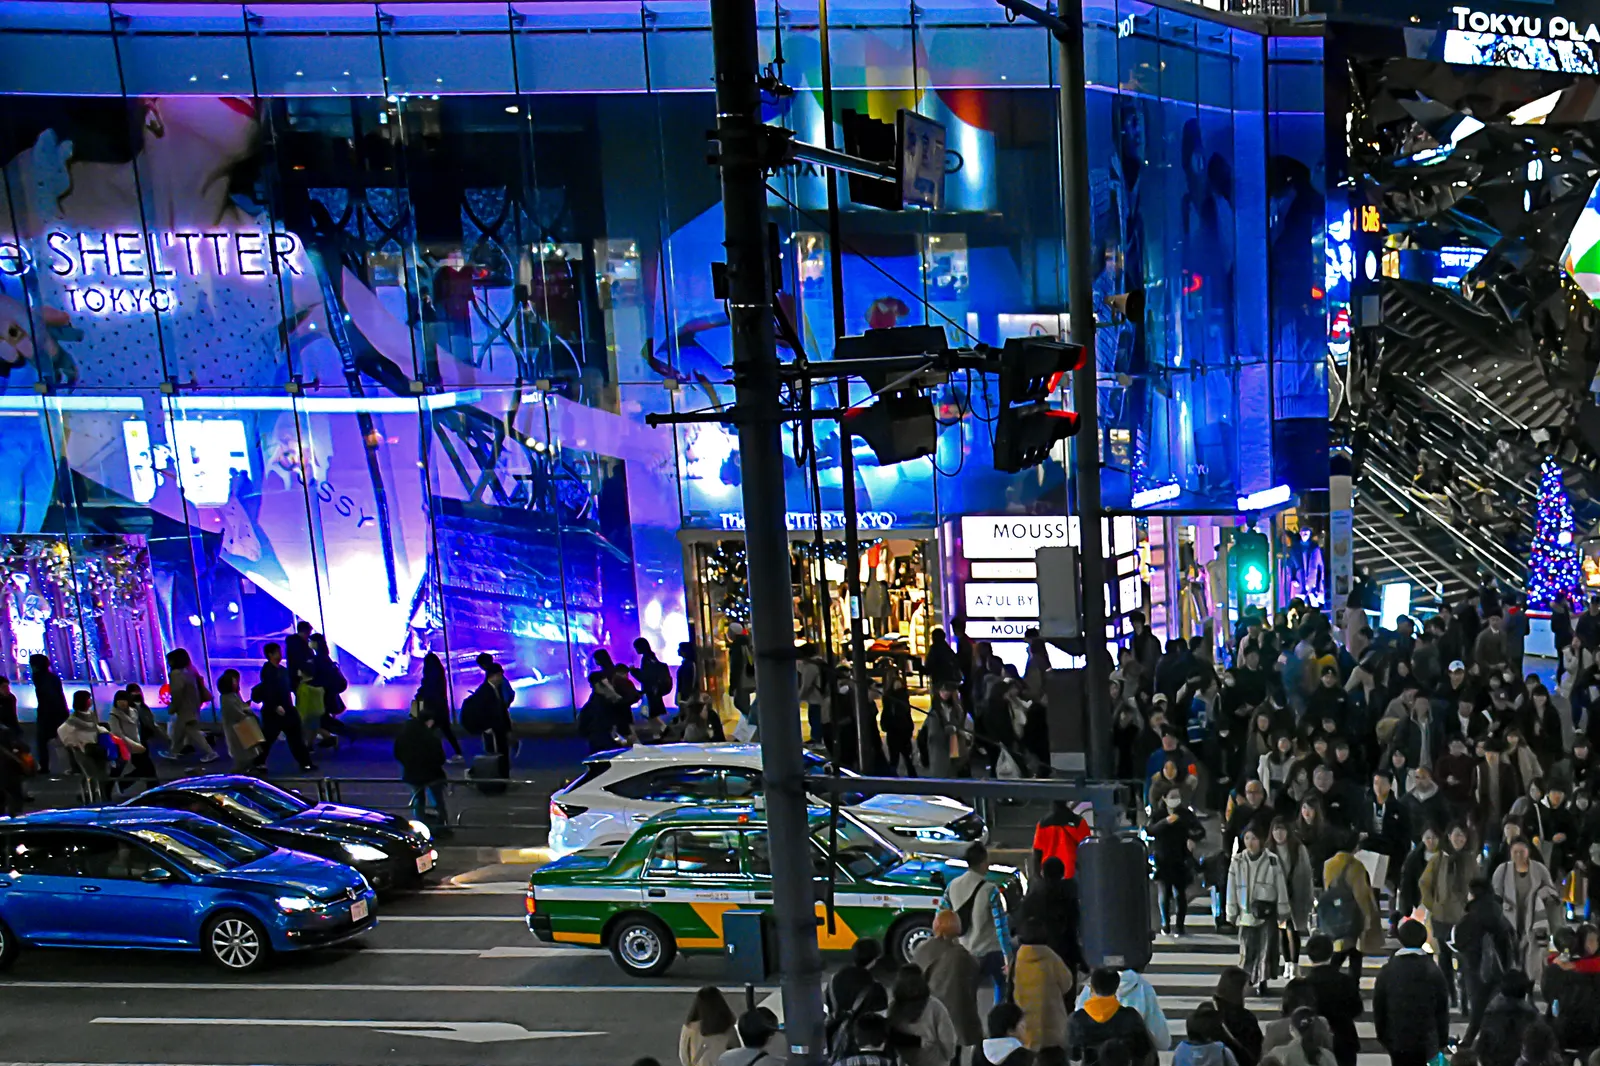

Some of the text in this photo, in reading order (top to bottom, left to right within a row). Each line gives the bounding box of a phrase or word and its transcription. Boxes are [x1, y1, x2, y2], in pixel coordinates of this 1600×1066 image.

[1452, 6, 1542, 36] TOKYU
[65, 288, 174, 312] TOKYO
[993, 523, 1077, 539] MOUSS
[975, 595, 1033, 606] AZUL BY
